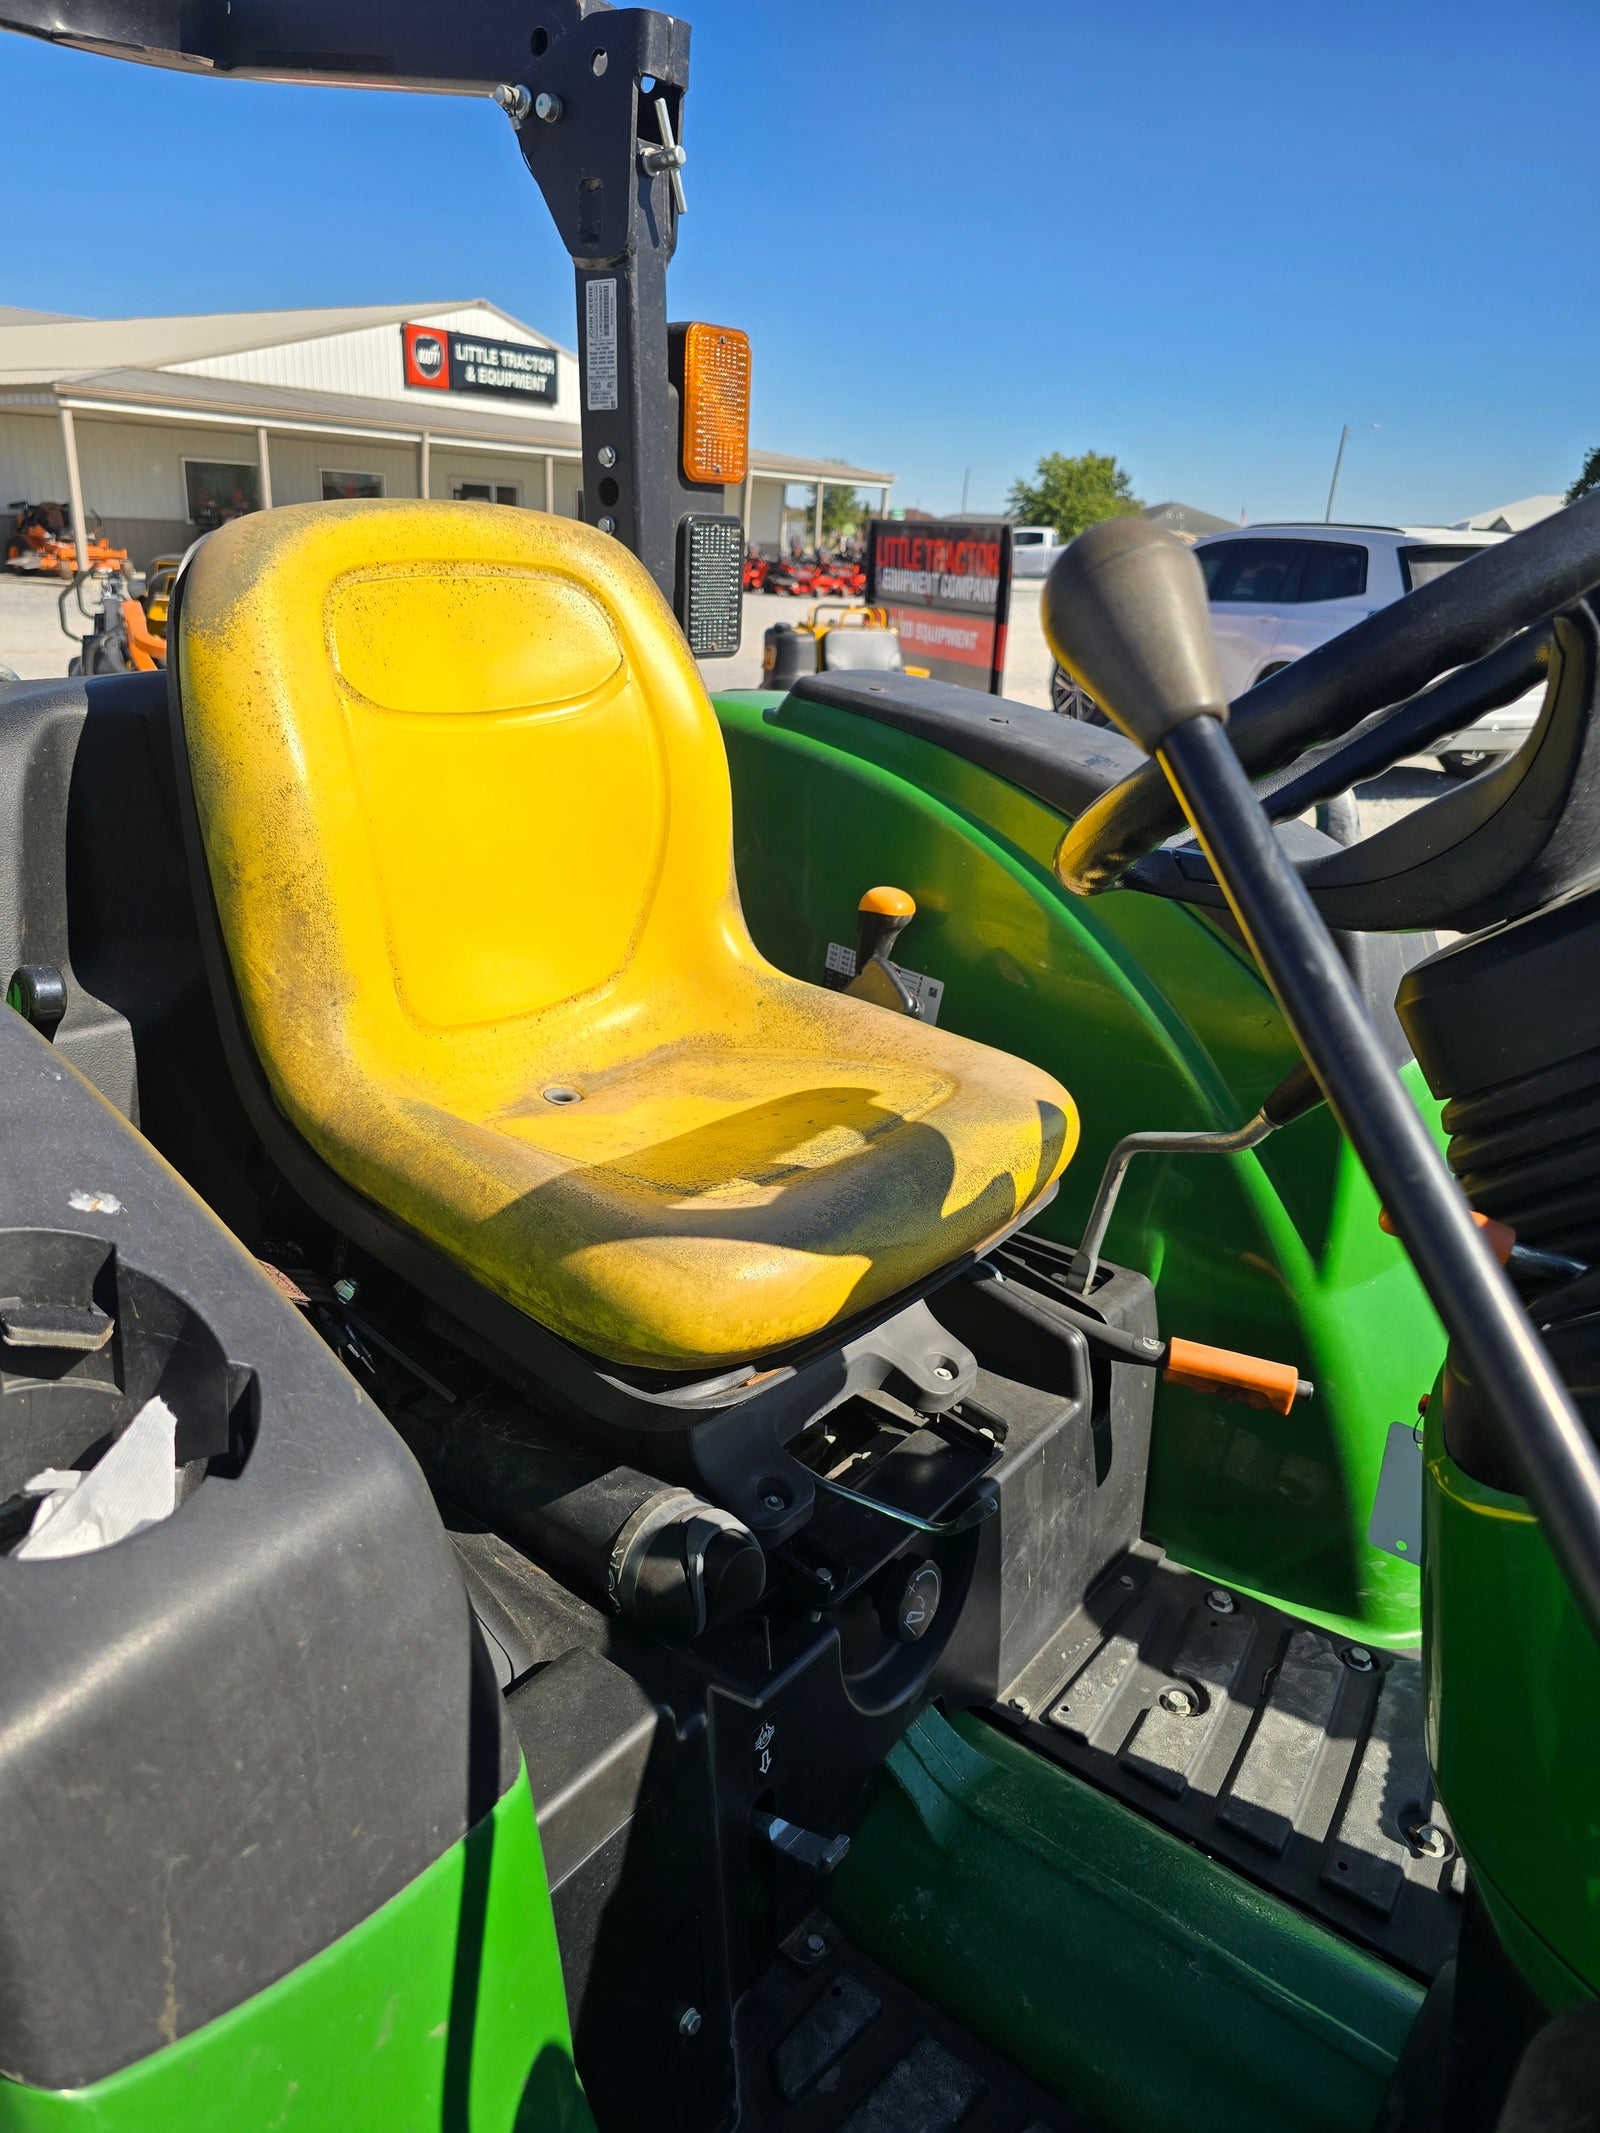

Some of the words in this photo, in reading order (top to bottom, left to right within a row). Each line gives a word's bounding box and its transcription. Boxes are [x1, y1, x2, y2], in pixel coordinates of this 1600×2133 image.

[455, 343, 499, 366] LITTLE
[499, 352, 555, 375] TRACTOR
[465, 364, 476, 383] &
[477, 366, 548, 392] EQUIPMENT
[876, 536, 922, 571] LITTLE
[924, 538, 1000, 577] TRACTOR
[882, 568, 941, 596] EQUIPMENT
[941, 574, 1000, 604] COMPANY
[915, 622, 979, 650] EQUIPMENT
